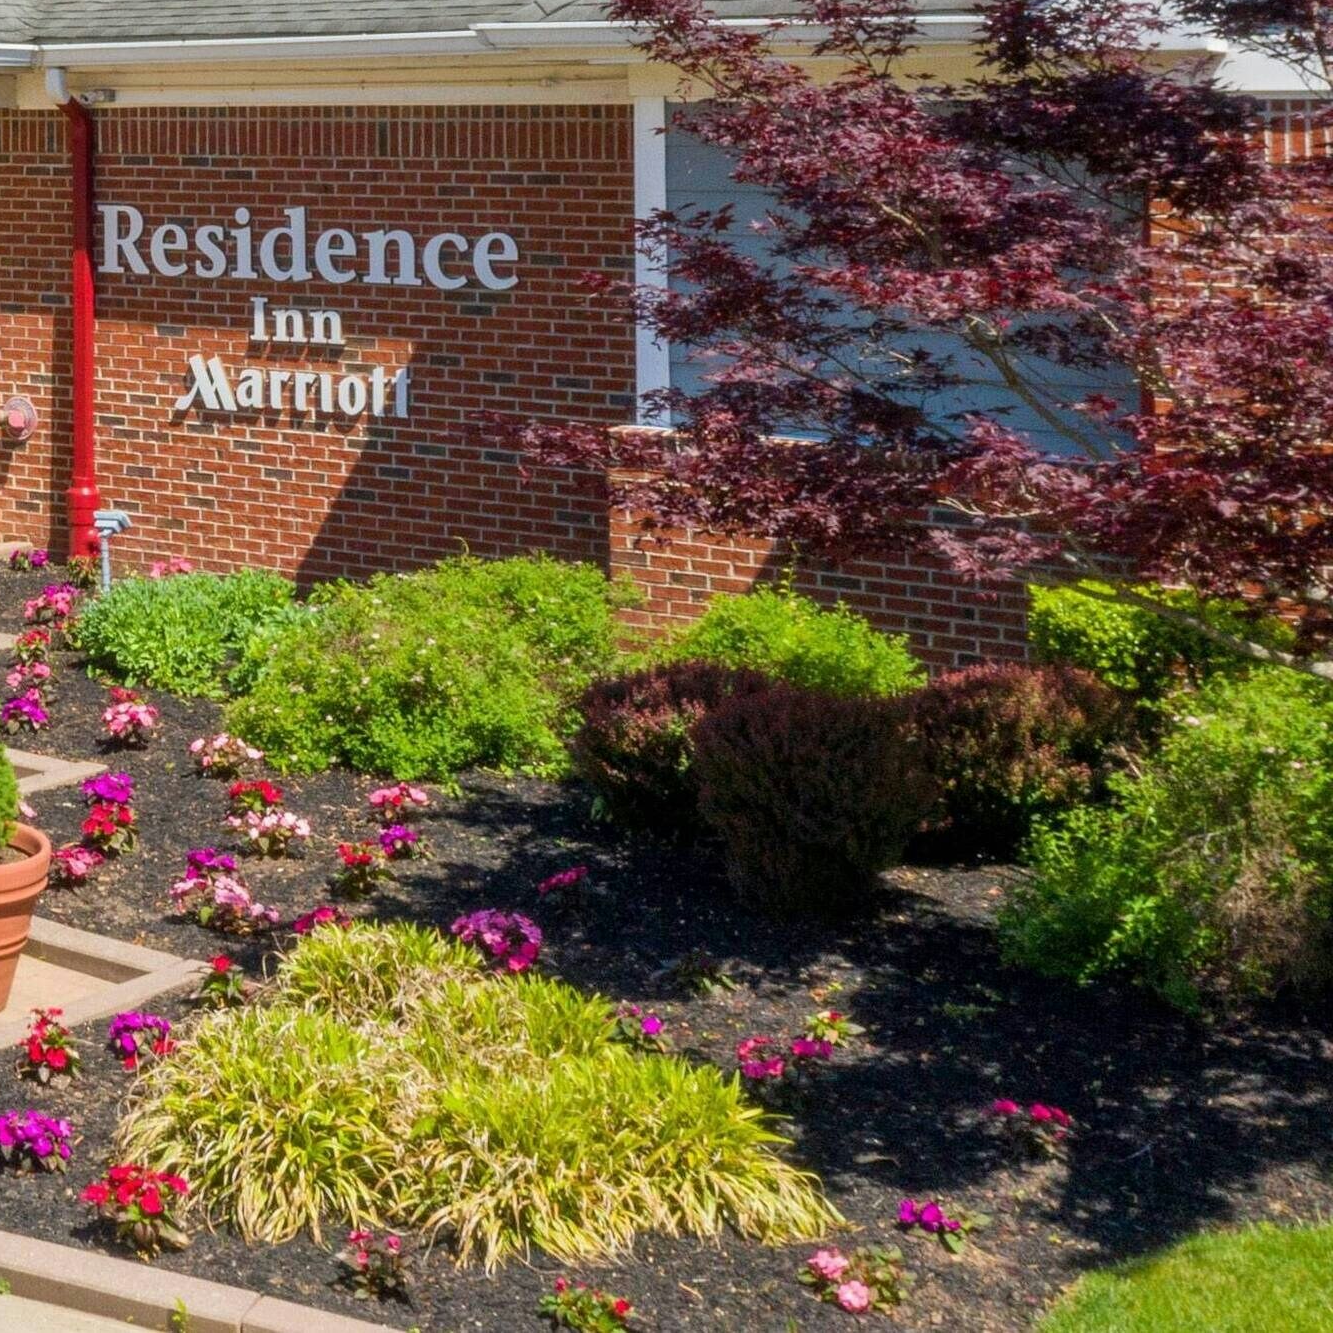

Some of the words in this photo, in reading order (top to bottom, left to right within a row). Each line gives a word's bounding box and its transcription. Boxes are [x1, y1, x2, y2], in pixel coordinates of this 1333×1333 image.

[96, 204, 520, 290] Residence
[249, 296, 344, 345] Inn
[174, 353, 411, 418] Marriott
